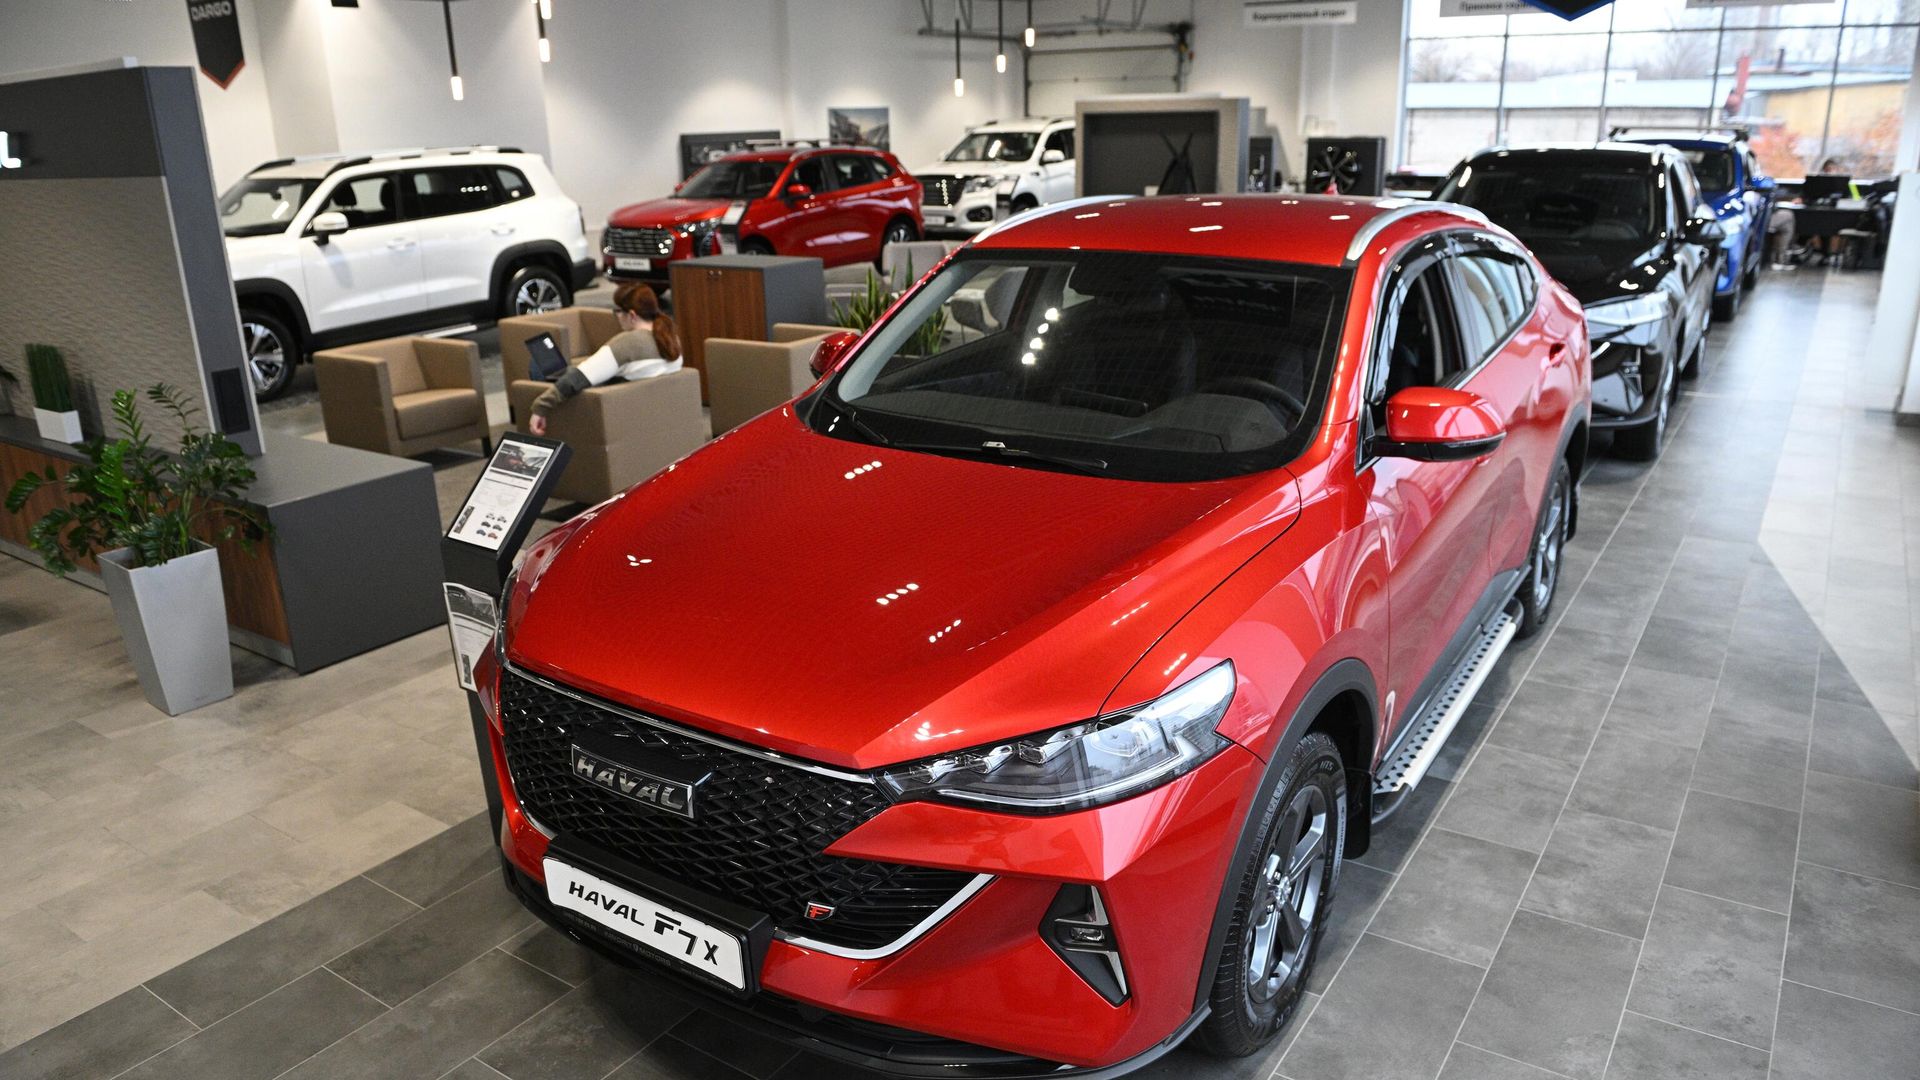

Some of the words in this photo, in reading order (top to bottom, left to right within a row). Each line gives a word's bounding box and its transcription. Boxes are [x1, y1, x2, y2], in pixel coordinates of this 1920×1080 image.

[191, 1, 232, 21] DARGO
[576, 755, 684, 809] HAVAL
[568, 881, 645, 927] HAVAL
